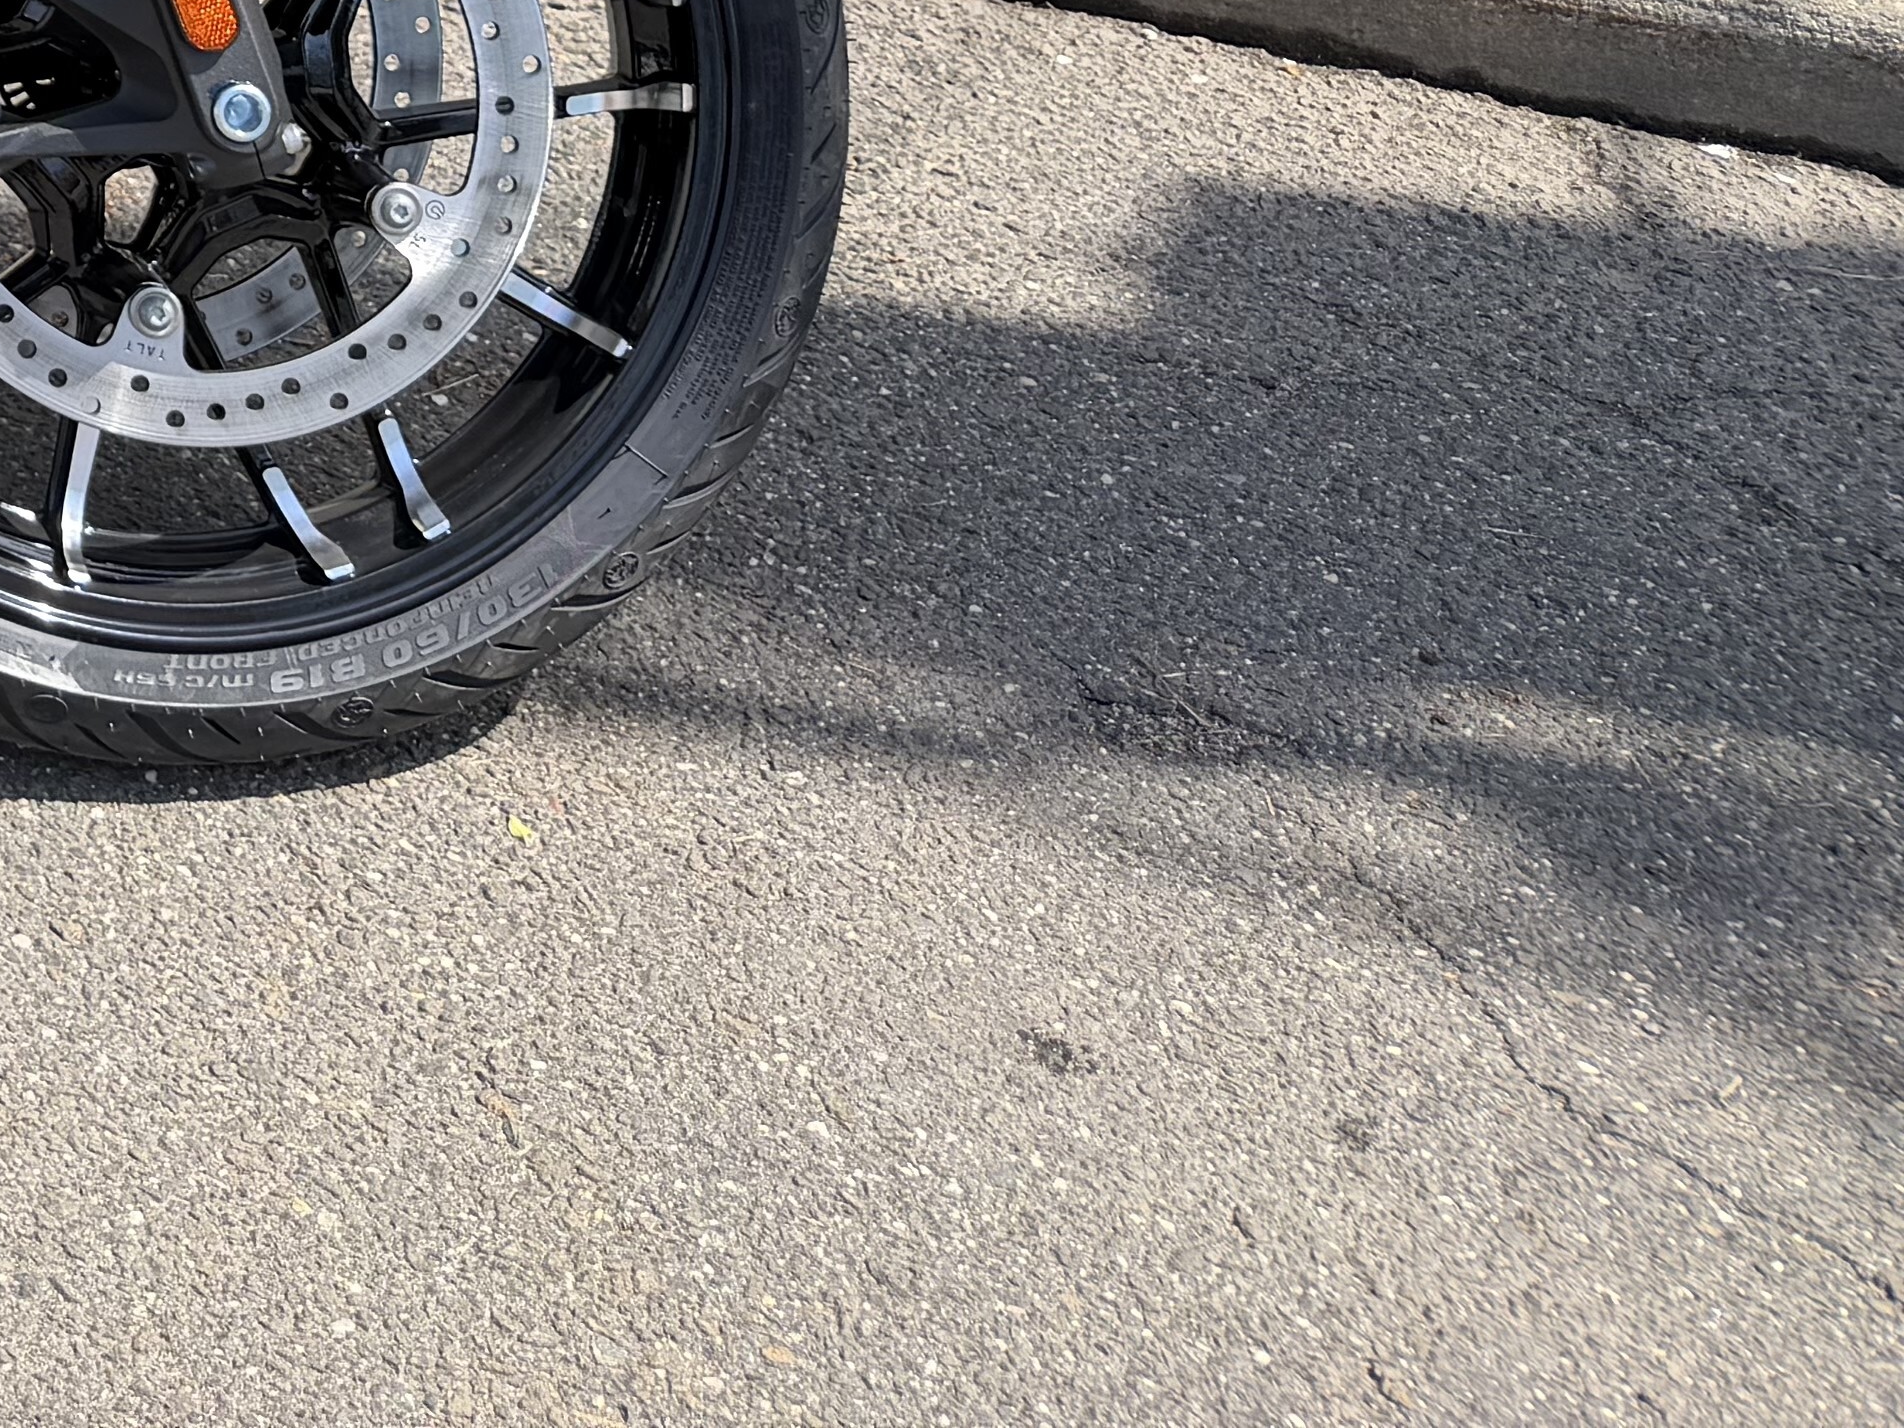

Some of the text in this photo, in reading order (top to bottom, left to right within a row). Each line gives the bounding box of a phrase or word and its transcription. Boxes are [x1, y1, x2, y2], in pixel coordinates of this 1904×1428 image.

[381, 562, 560, 668] 130/60
[163, 649, 278, 670] FRONT
[269, 652, 366, 694] B19
